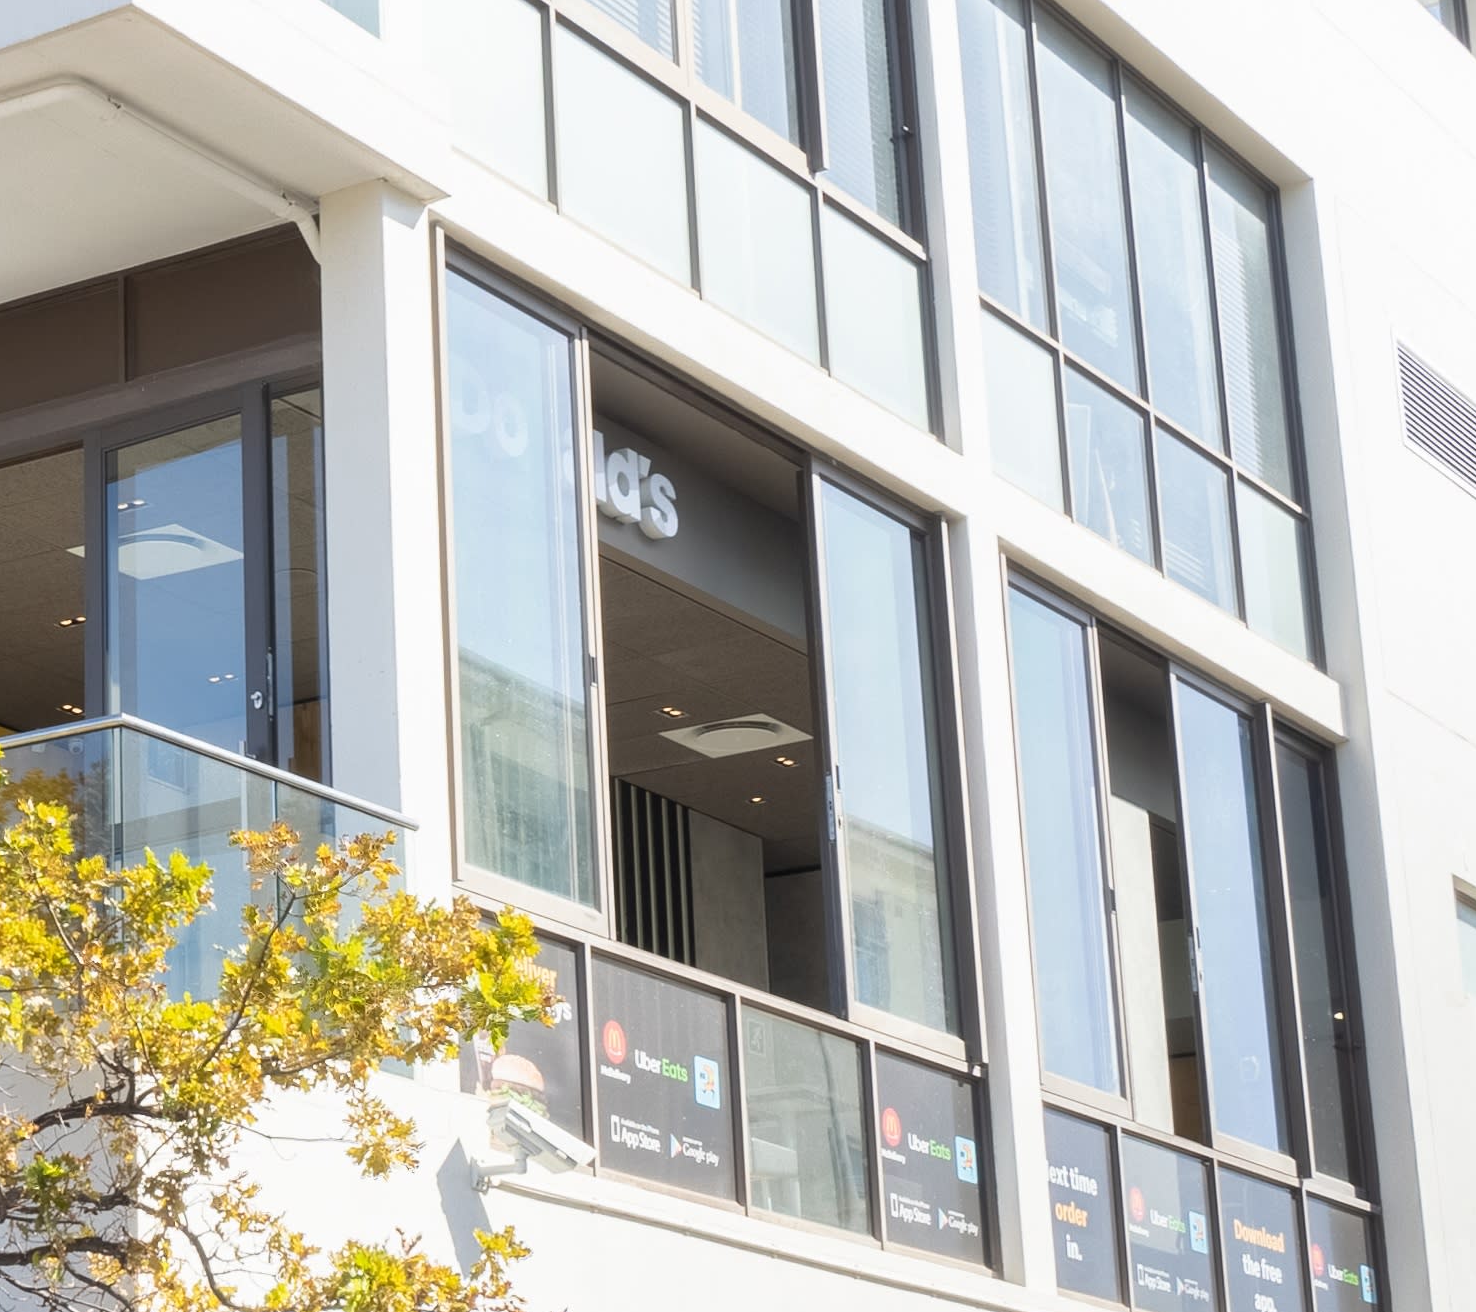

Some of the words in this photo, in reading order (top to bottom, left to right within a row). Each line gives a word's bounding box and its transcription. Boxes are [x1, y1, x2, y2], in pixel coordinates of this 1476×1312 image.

[635, 1049, 661, 1075] Uber
[662, 1058, 688, 1082] Eats
[621, 1127, 639, 1148] App
[639, 1133, 661, 1153] Store
[682, 1143, 706, 1165] Google
[908, 1133, 929, 1154] Uber
[930, 1139, 951, 1161] Eats
[1070, 1167, 1098, 1196] time
[1055, 1201, 1088, 1228] order
[1065, 1234, 1083, 1261] in.
[1233, 1219, 1285, 1254] Download
[1242, 1254, 1260, 1279] the
[1261, 1258, 1283, 1284] free
